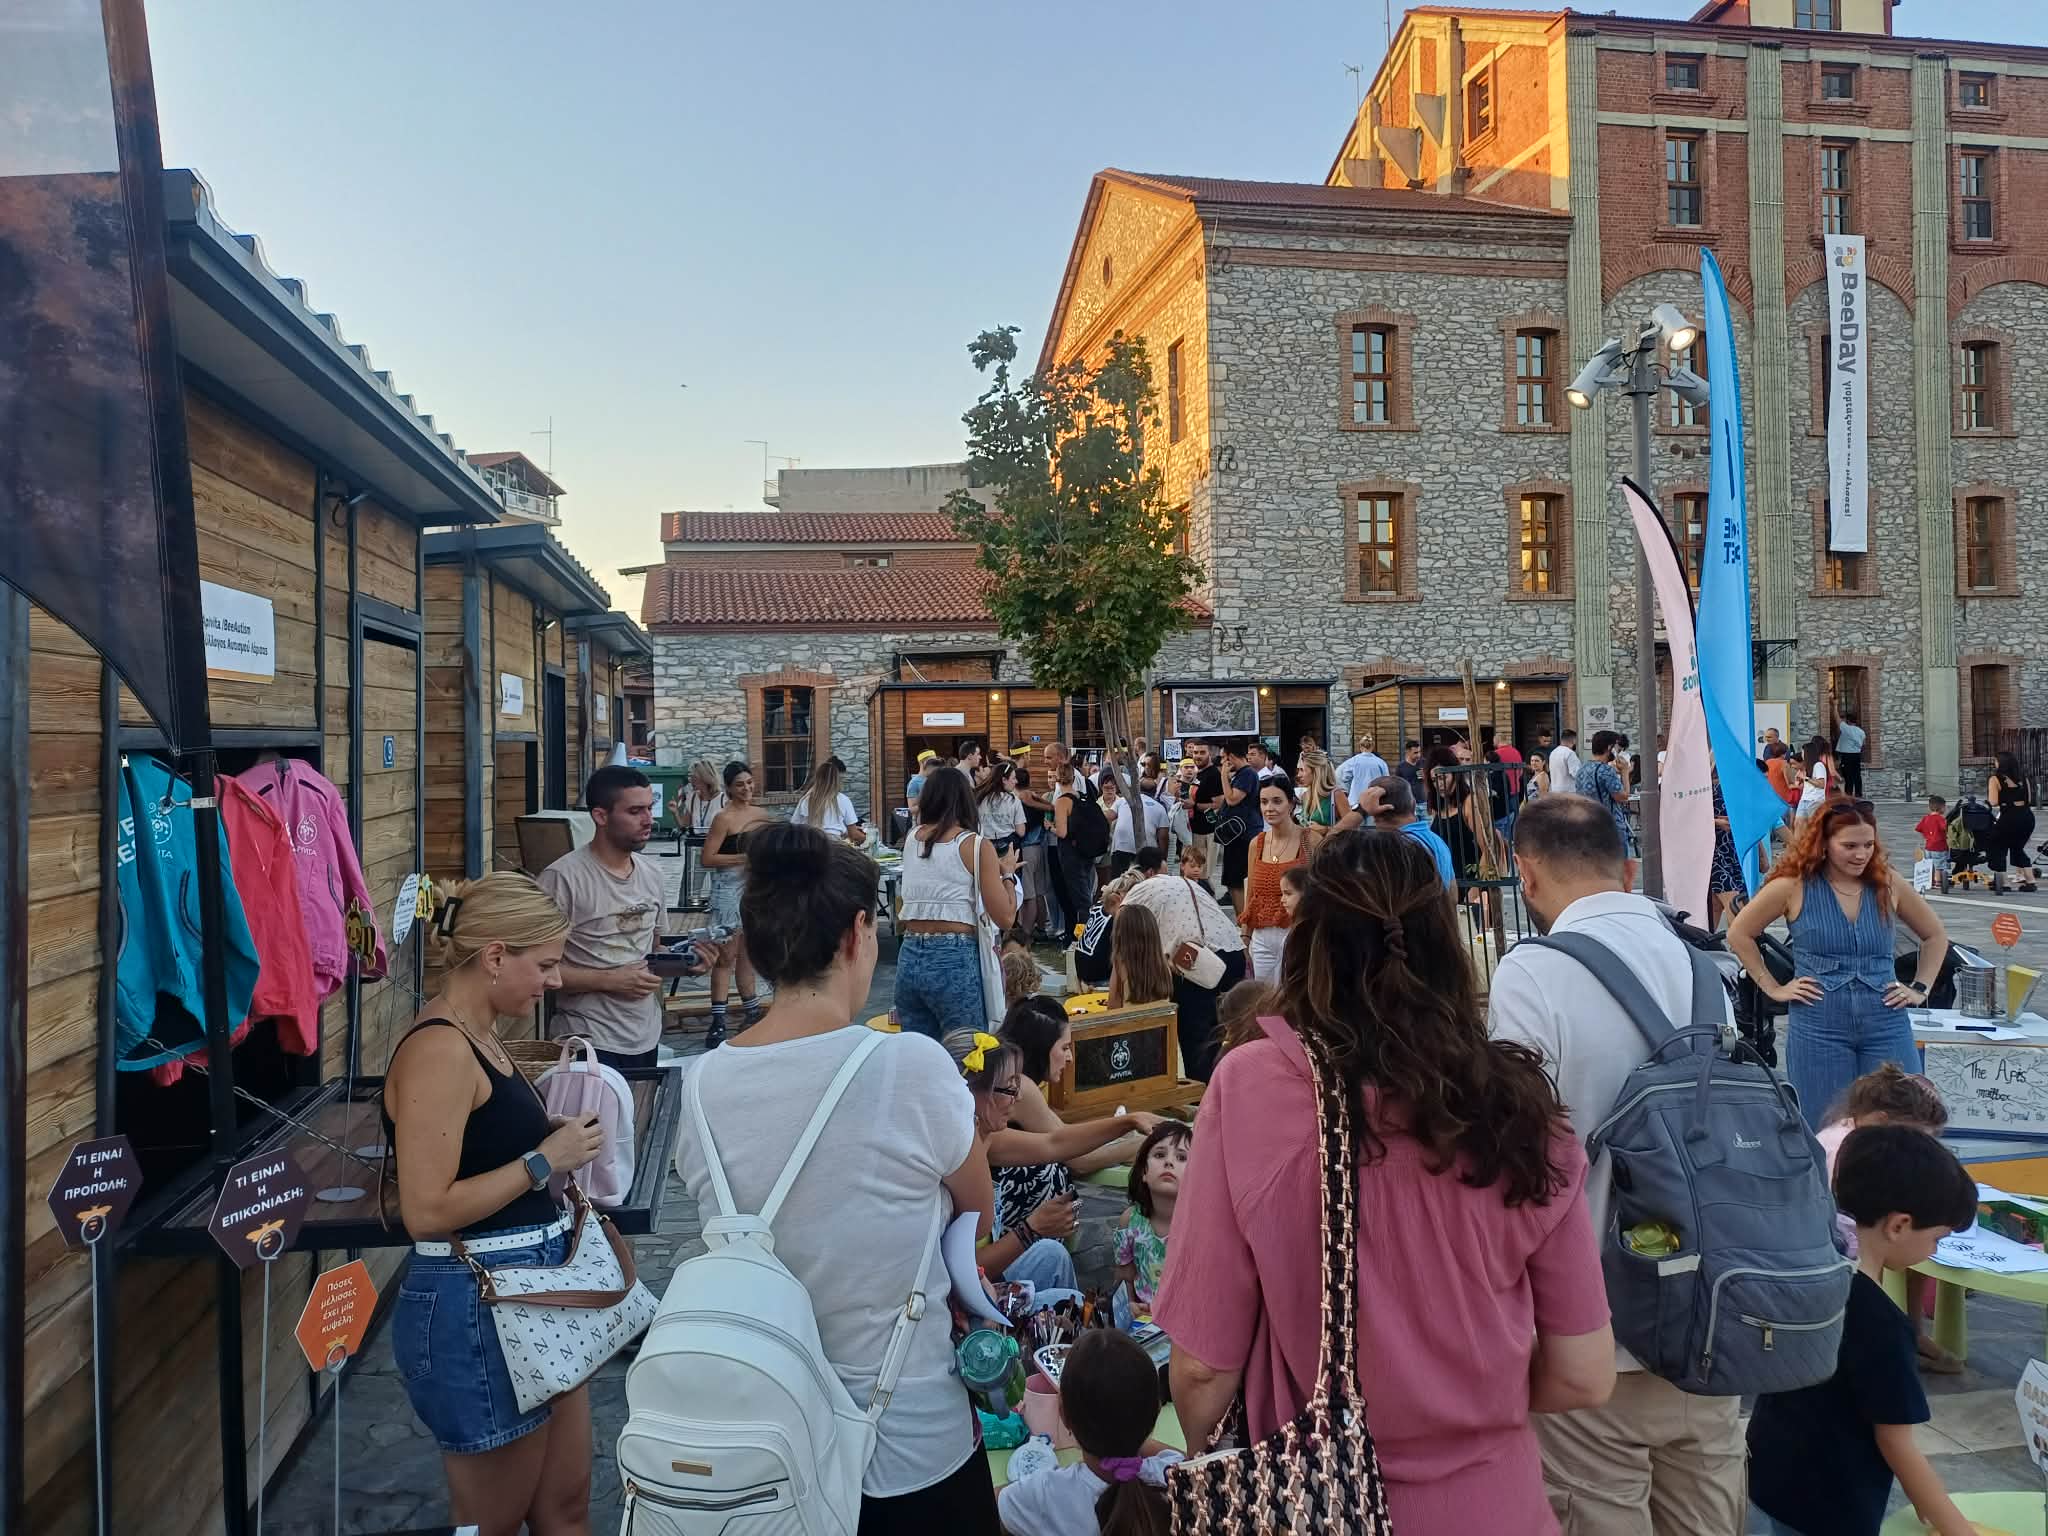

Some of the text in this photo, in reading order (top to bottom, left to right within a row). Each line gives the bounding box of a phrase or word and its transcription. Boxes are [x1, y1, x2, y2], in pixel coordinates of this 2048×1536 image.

[1837, 272, 1859, 375] BeeDay
[1968, 1060, 1987, 1080] The
[75, 1147, 123, 1168] ΤΙ ΕΙΝΑΙ
[93, 1166, 103, 1180] Η
[235, 1161, 285, 1189] ΤΙ ΕΙΝΑΙ
[64, 1177, 128, 1202] ΠΡΟΠΟΛΗ;
[257, 1184, 267, 1197] Η
[221, 1186, 304, 1228] ΕΠΙΚΟΝΙΑΣΗ;
[327, 1276, 353, 1293] Πόσες
[321, 1287, 357, 1310] μέλισσες
[322, 1308, 340, 1321] έχει
